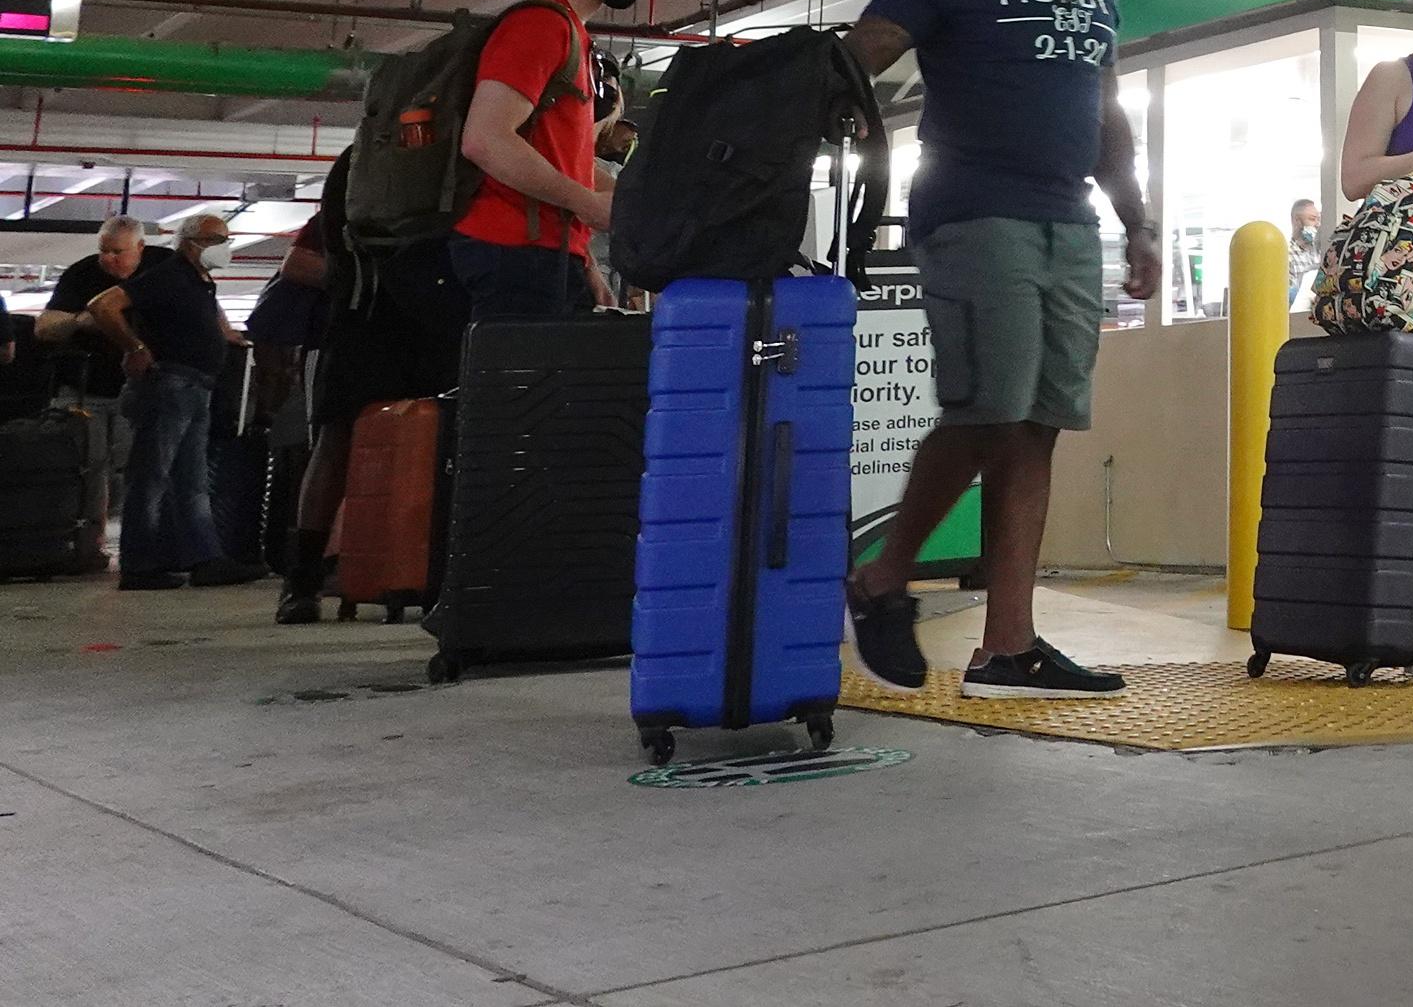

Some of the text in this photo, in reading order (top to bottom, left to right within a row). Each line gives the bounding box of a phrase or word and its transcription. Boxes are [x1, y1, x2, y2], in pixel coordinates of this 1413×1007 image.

[858, 326, 931, 349] ur saf
[856, 359, 898, 376] our
[852, 380, 921, 407] iority.
[852, 418, 881, 432] ase
[851, 436, 921, 454] ial dista
[850, 459, 912, 476] delines
